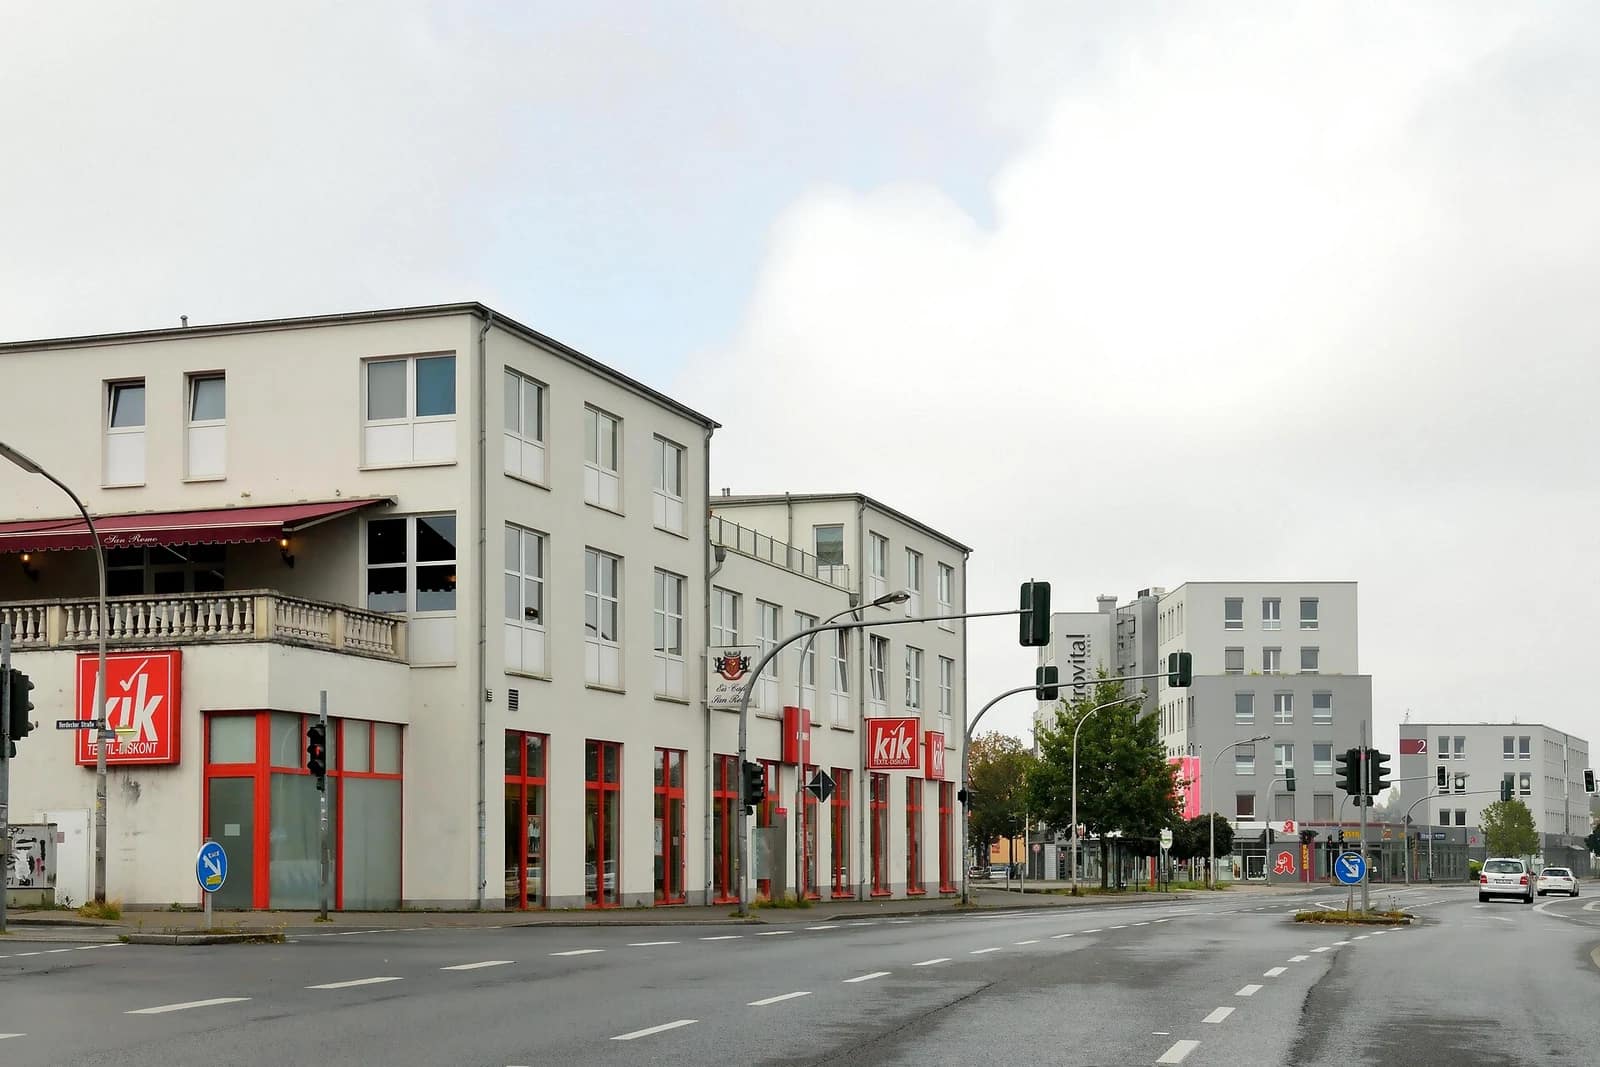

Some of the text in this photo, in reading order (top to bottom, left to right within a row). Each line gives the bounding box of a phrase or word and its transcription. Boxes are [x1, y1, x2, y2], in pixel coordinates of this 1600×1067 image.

[87, 659, 164, 743] kik
[873, 721, 913, 760] kik
[1417, 739, 1427, 754] 2
